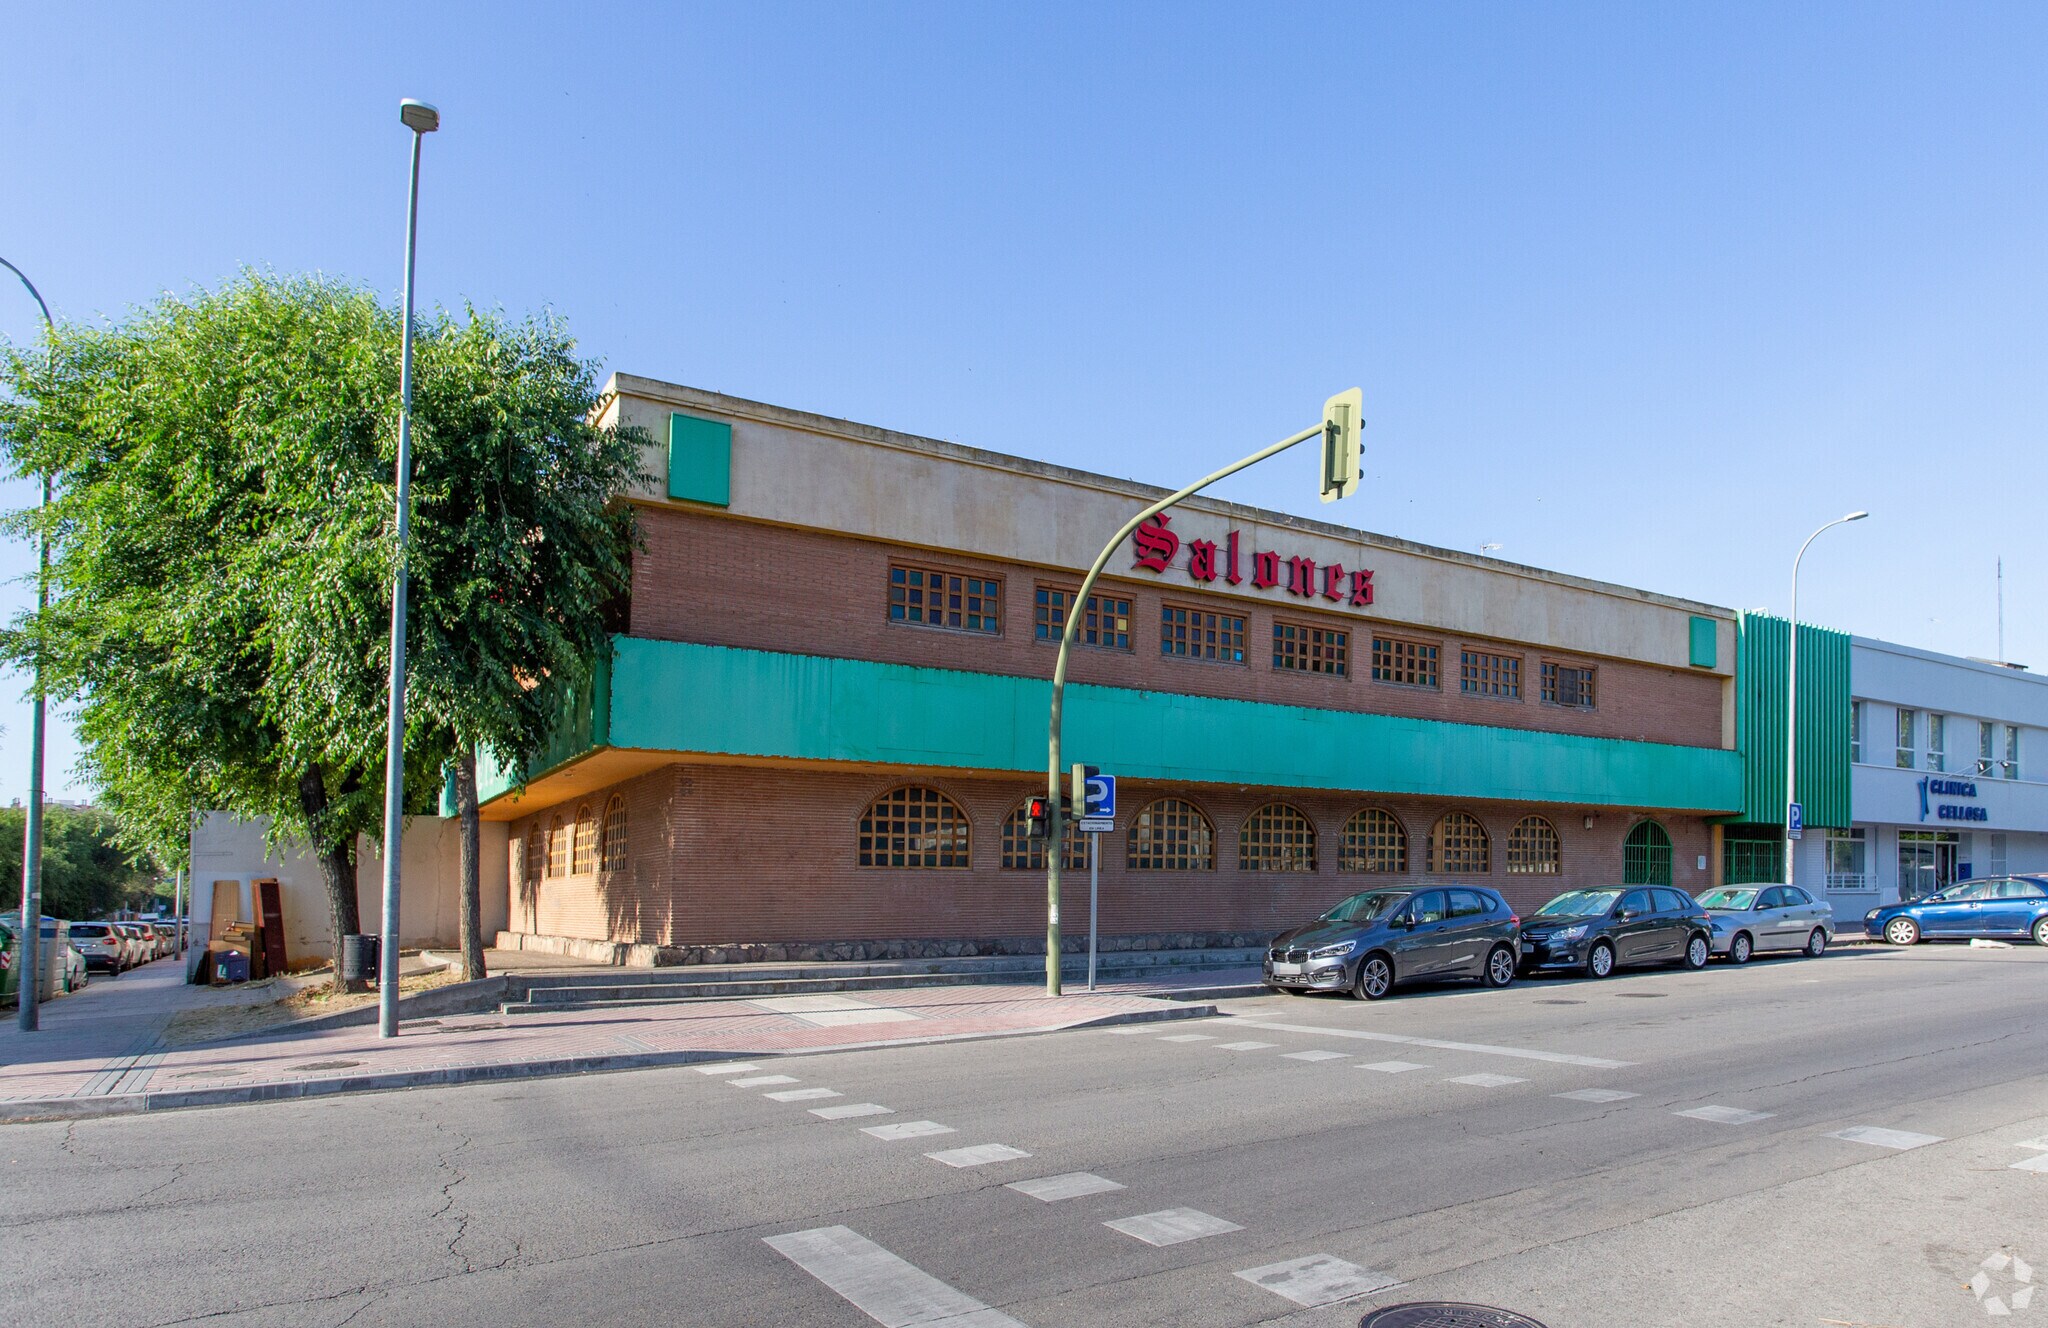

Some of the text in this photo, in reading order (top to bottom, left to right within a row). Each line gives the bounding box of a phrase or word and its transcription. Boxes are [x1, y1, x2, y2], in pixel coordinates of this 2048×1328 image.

[1132, 511, 1375, 606] Salones
[1930, 779, 1977, 797] CLINICA
[1791, 806, 1800, 827] P
